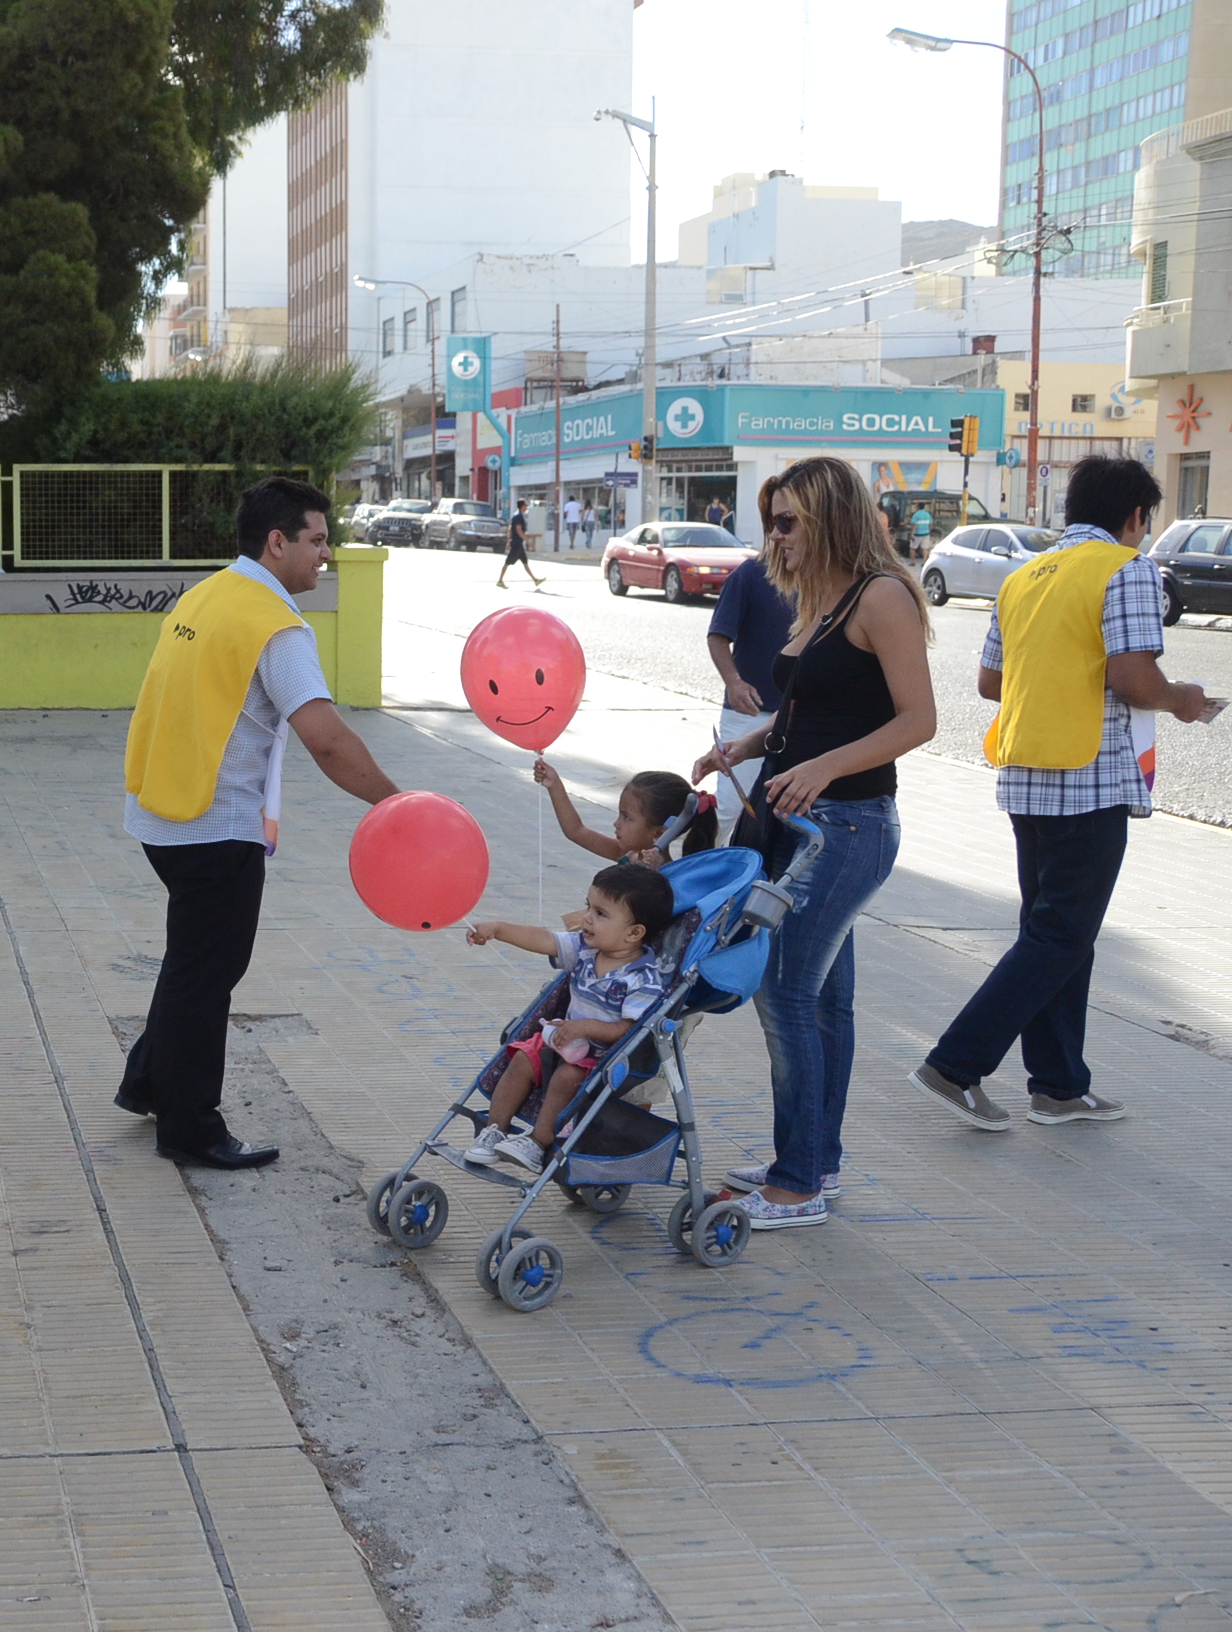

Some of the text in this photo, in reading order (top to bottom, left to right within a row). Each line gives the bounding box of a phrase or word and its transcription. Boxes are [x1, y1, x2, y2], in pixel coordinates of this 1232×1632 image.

[517, 413, 617, 449] Farmaci SOCIAL
[737, 412, 943, 433] Farmacia SOCIAL
[1035, 564, 1058, 581] pro
[175, 624, 196, 641] pro
